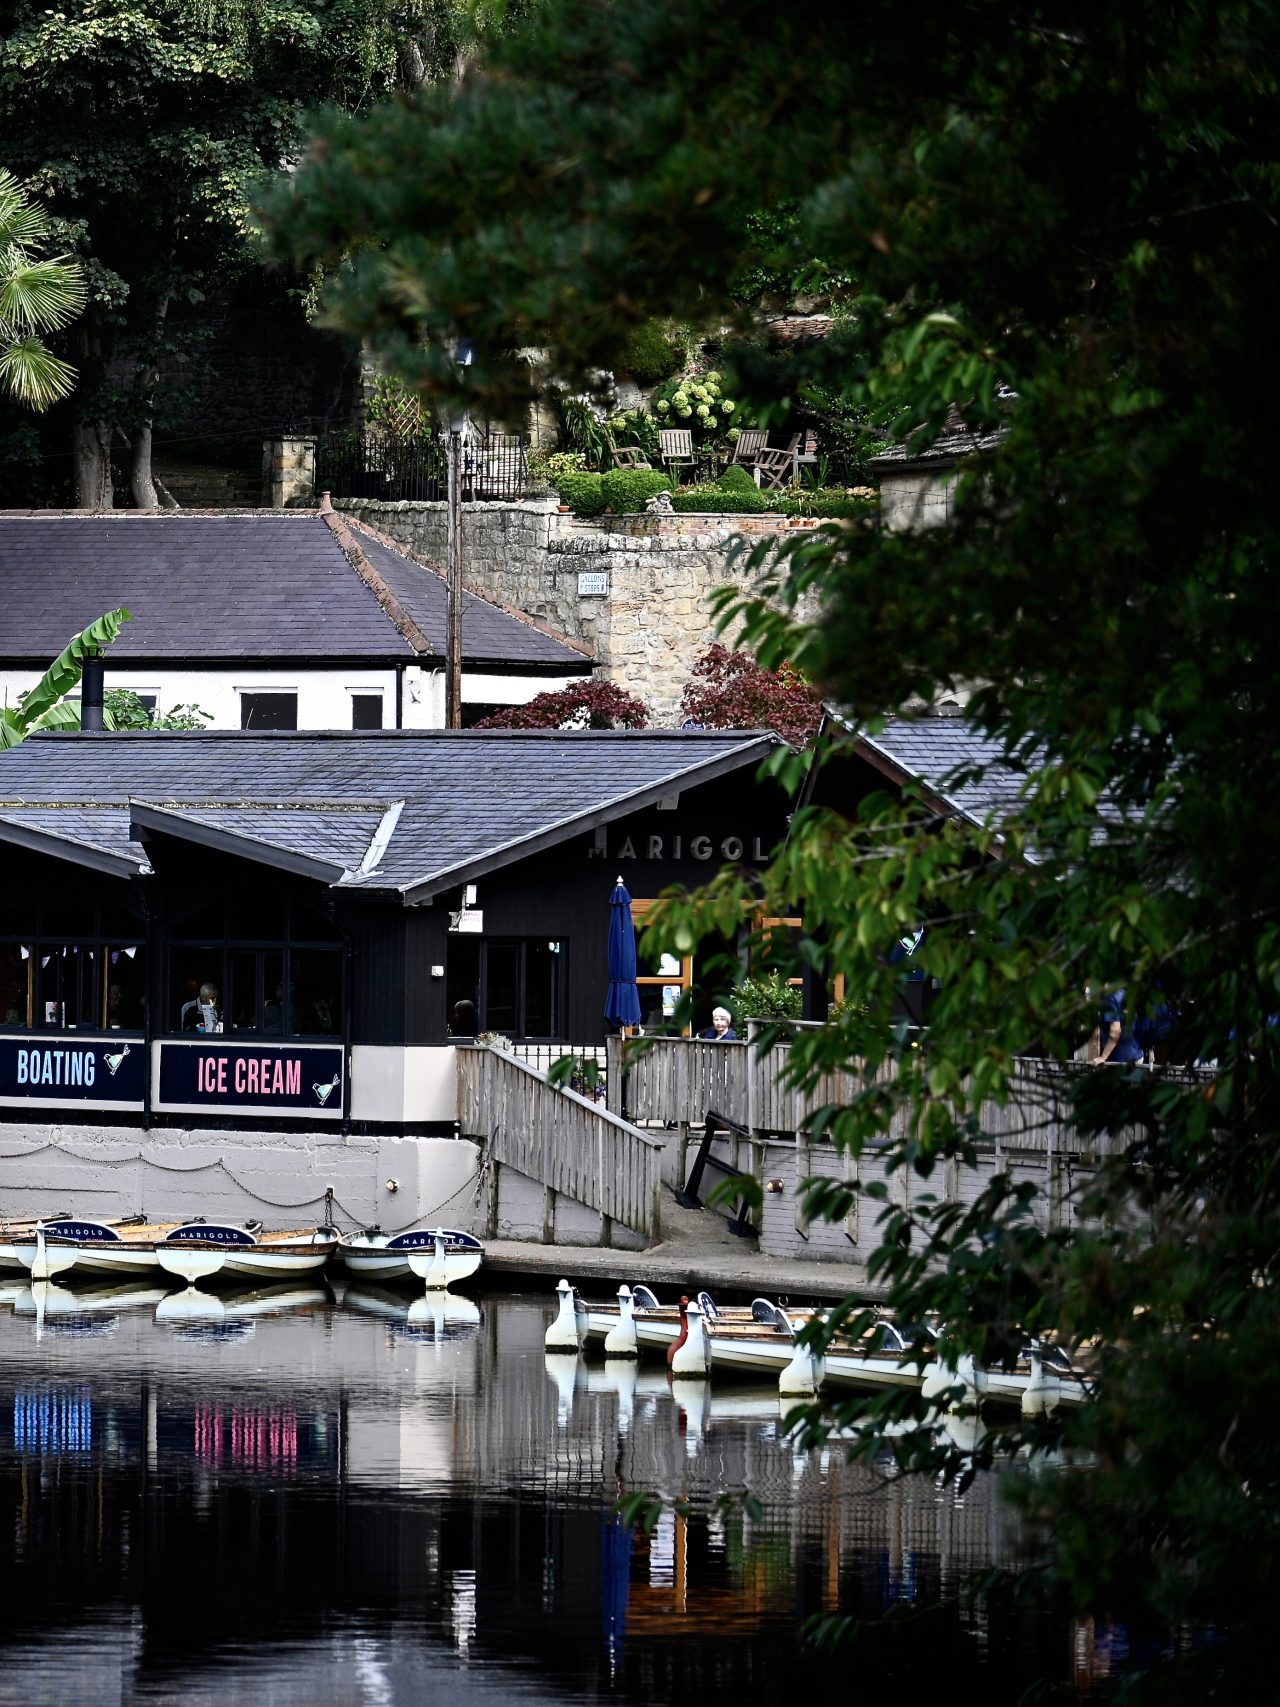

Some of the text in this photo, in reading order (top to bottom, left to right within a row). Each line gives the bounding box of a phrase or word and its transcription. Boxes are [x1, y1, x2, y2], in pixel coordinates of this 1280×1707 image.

[580, 574, 605, 583] GALLONS
[584, 584, 600, 593] STEPS
[588, 835, 769, 861] MARIGOL
[17, 1050, 96, 1087] BOATING
[197, 1057, 301, 1095] ICE CREAM
[180, 1232, 239, 1240] MARIGOLD
